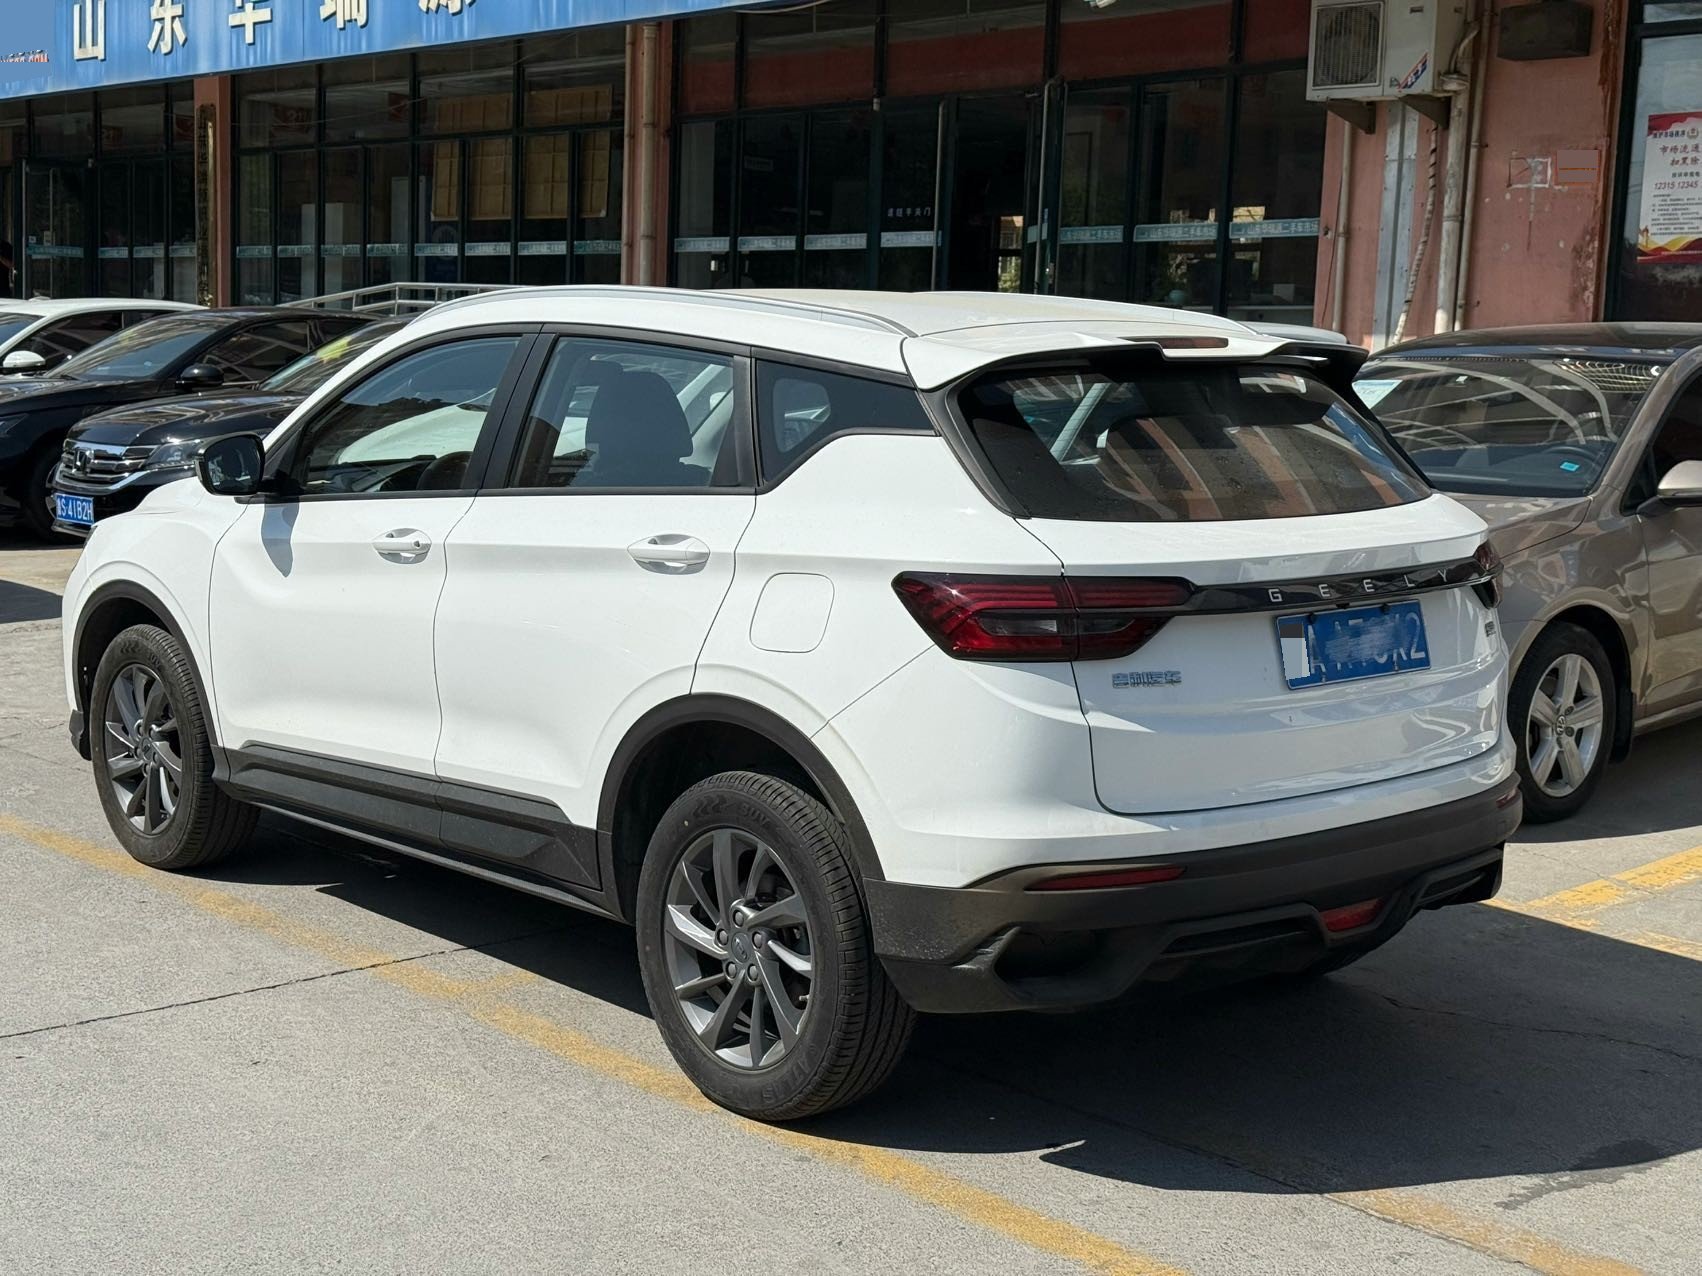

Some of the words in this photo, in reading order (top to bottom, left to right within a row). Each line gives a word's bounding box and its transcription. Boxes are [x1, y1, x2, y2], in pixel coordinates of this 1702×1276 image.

[1654, 181, 1676, 190] 12315
[1677, 180, 1699, 189] 12345
[1268, 569, 1448, 602] GEELY
[1112, 671, 1182, 689] 吉利汽车
